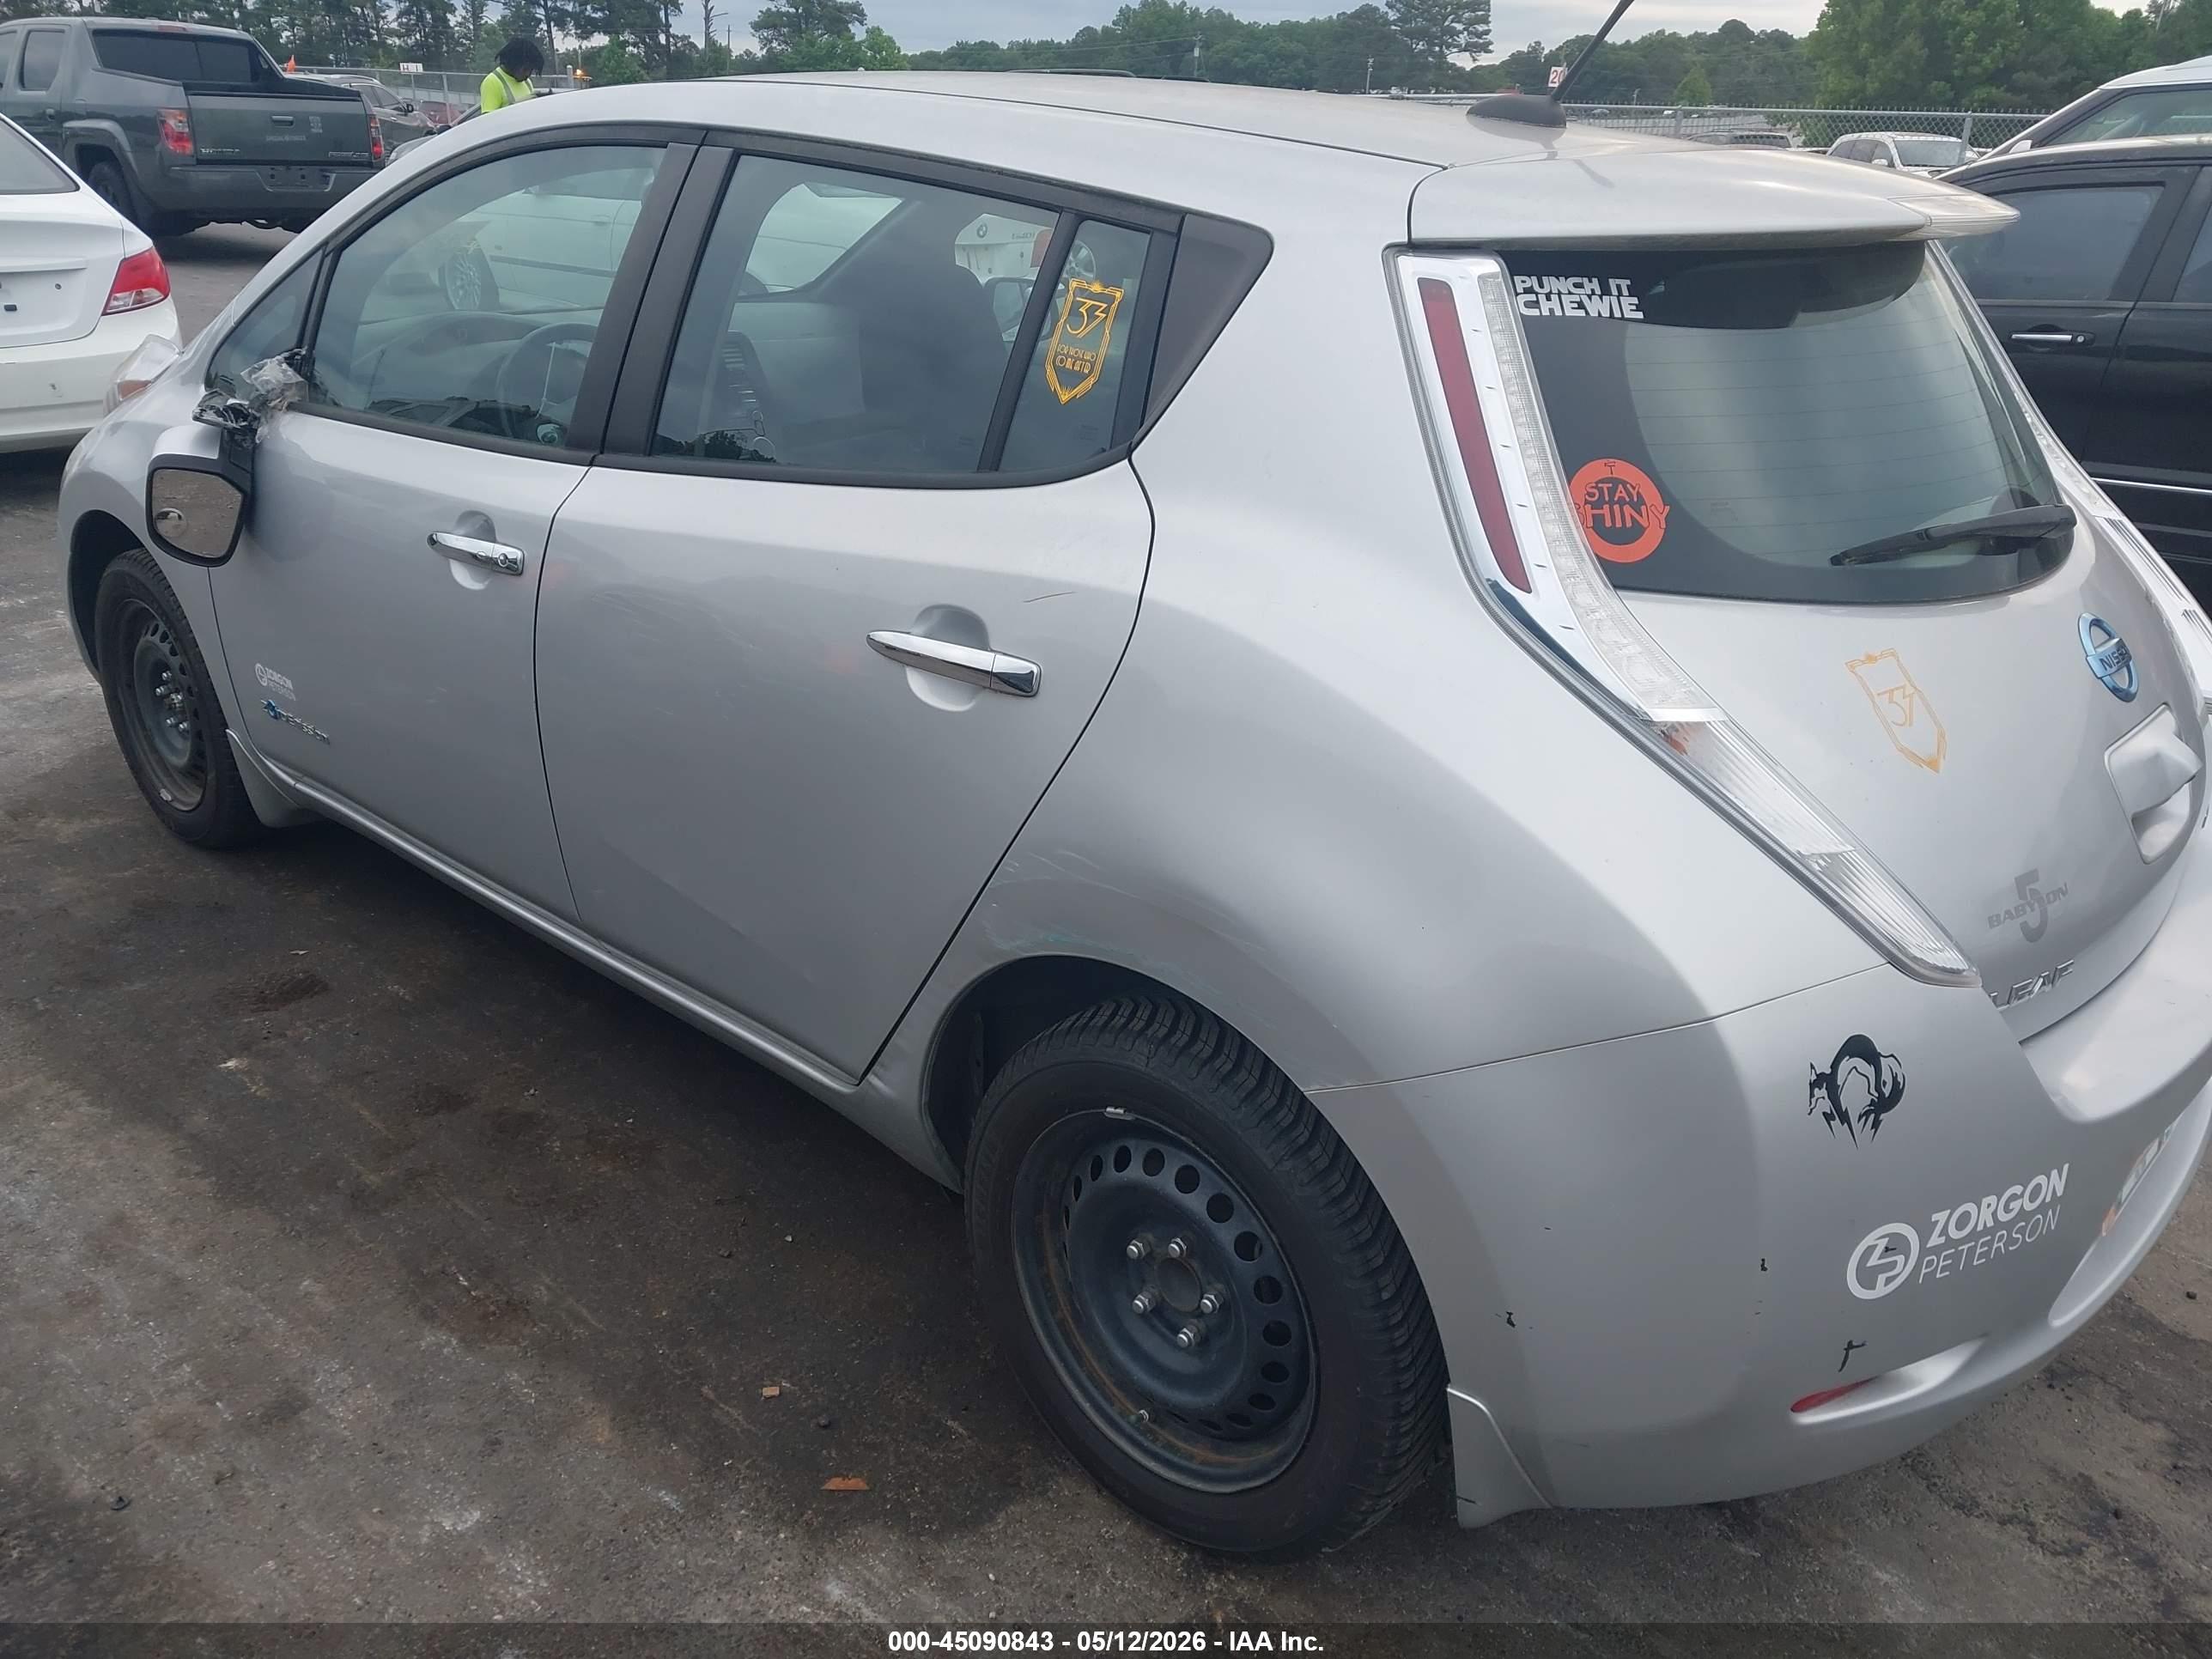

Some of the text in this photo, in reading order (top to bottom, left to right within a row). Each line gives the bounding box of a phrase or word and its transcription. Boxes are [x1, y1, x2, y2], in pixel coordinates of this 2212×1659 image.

[1514, 276, 1632, 296] PUNCH IT
[1516, 294, 1644, 319] CHEWIE
[1584, 483, 1640, 502] STAY
[2099, 646, 2131, 671] NISS
[2014, 868, 2048, 943] 5
[1990, 959, 2075, 1010] LEAF
[1926, 1163, 2069, 1248] ZORGON
[1918, 1204, 2061, 1285] PETERSON
